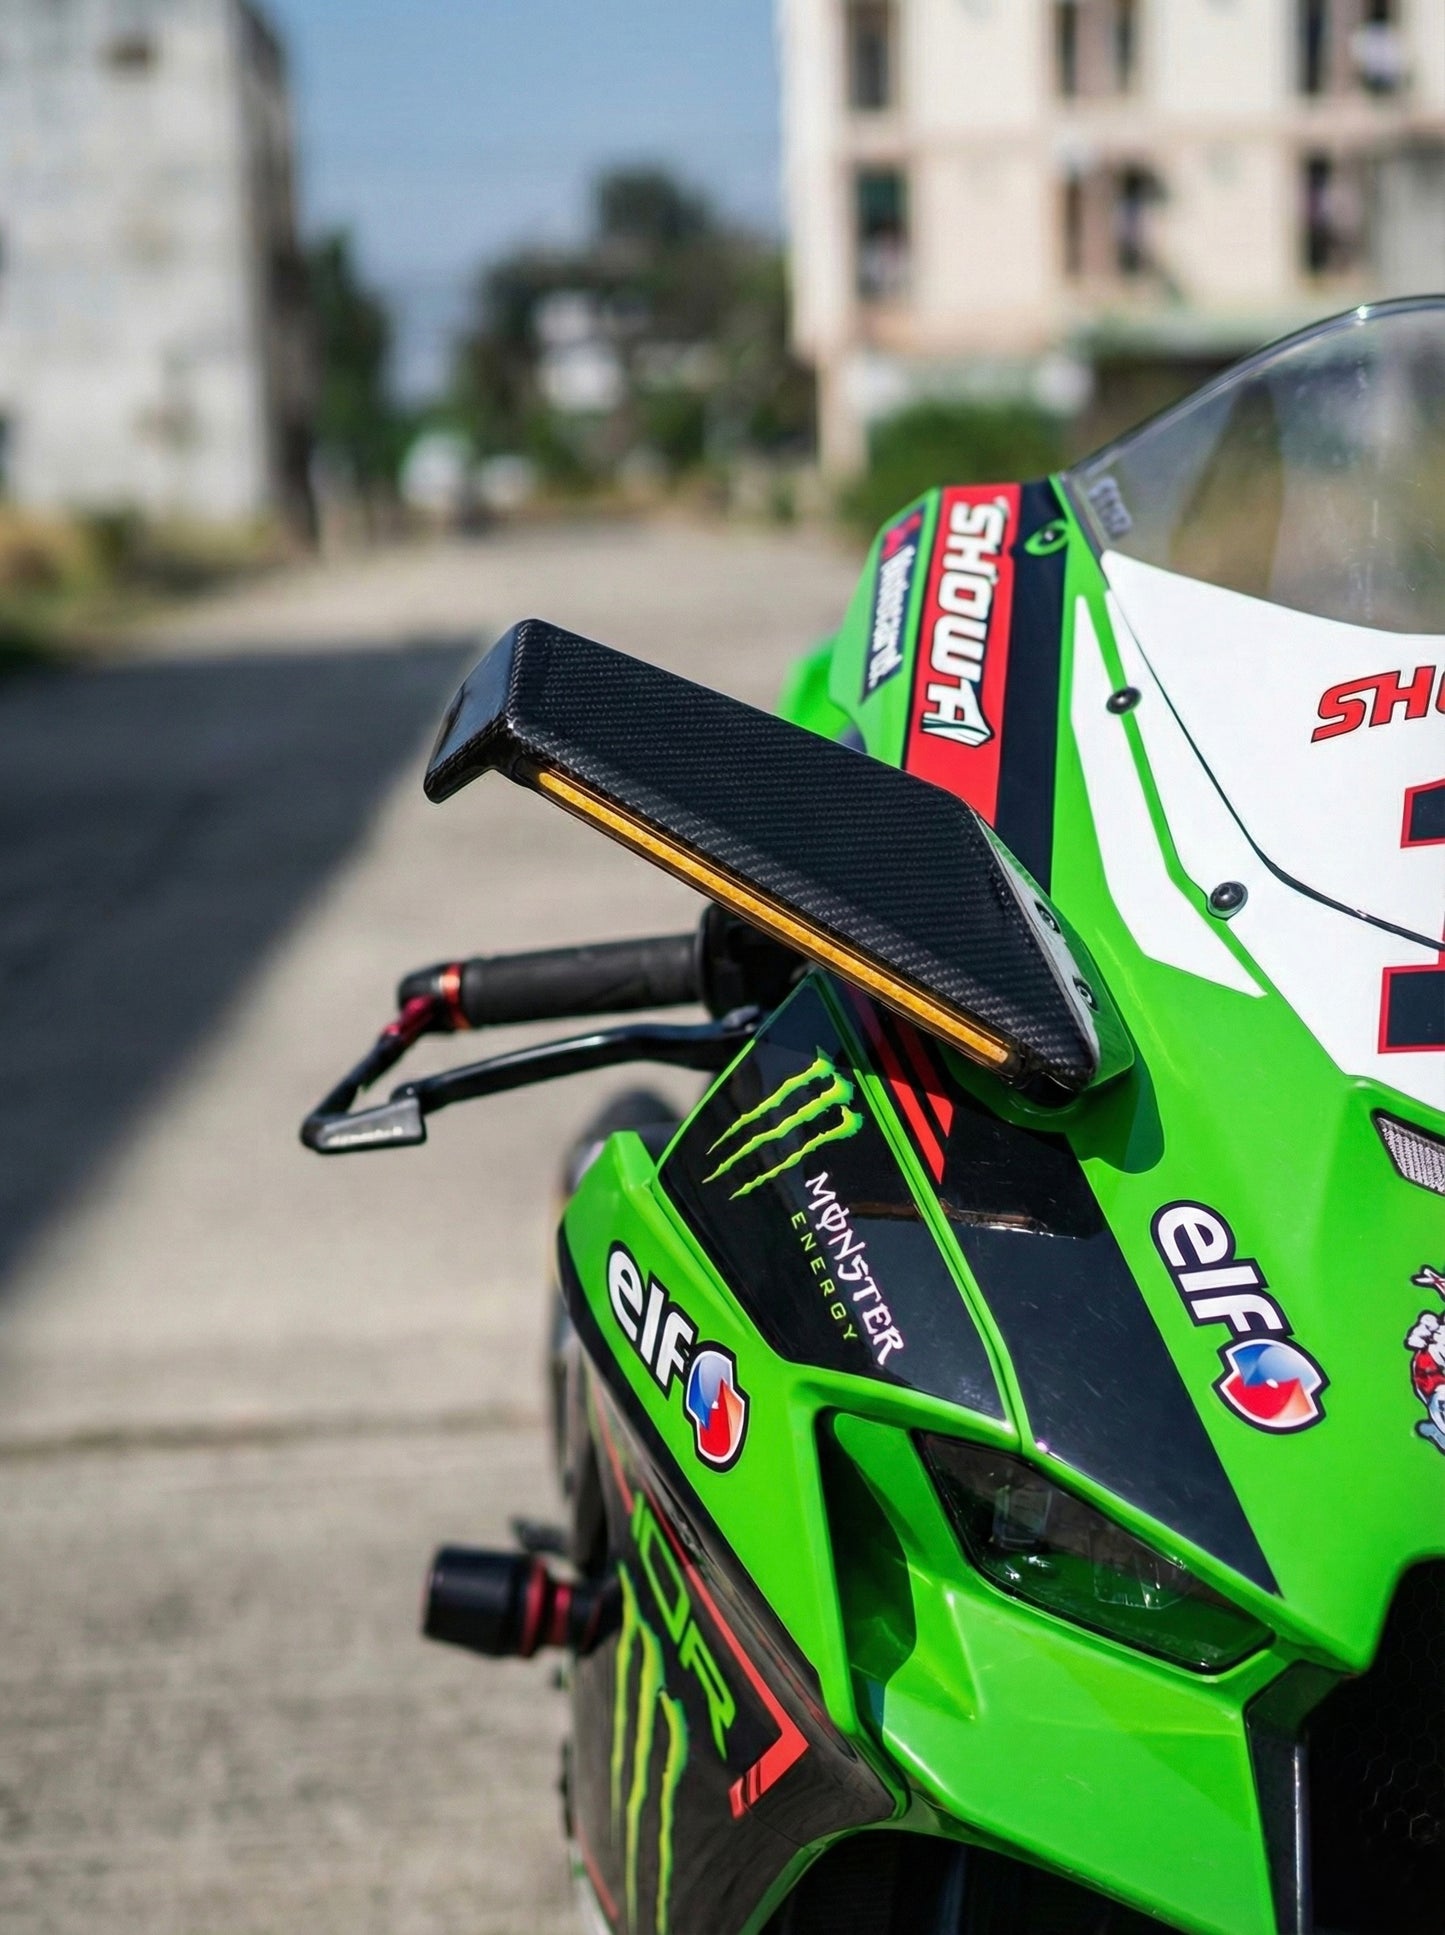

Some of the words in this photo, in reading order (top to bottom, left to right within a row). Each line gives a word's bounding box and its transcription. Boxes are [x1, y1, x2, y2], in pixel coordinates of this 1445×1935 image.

[921, 496, 1009, 747] SHOWA
[1310, 664, 1445, 743] SH
[608, 1250, 694, 1387] elf
[791, 1211, 858, 1341] ENERGY
[804, 1171, 904, 1365] MONSTER
[1158, 1206, 1283, 1332] elf
